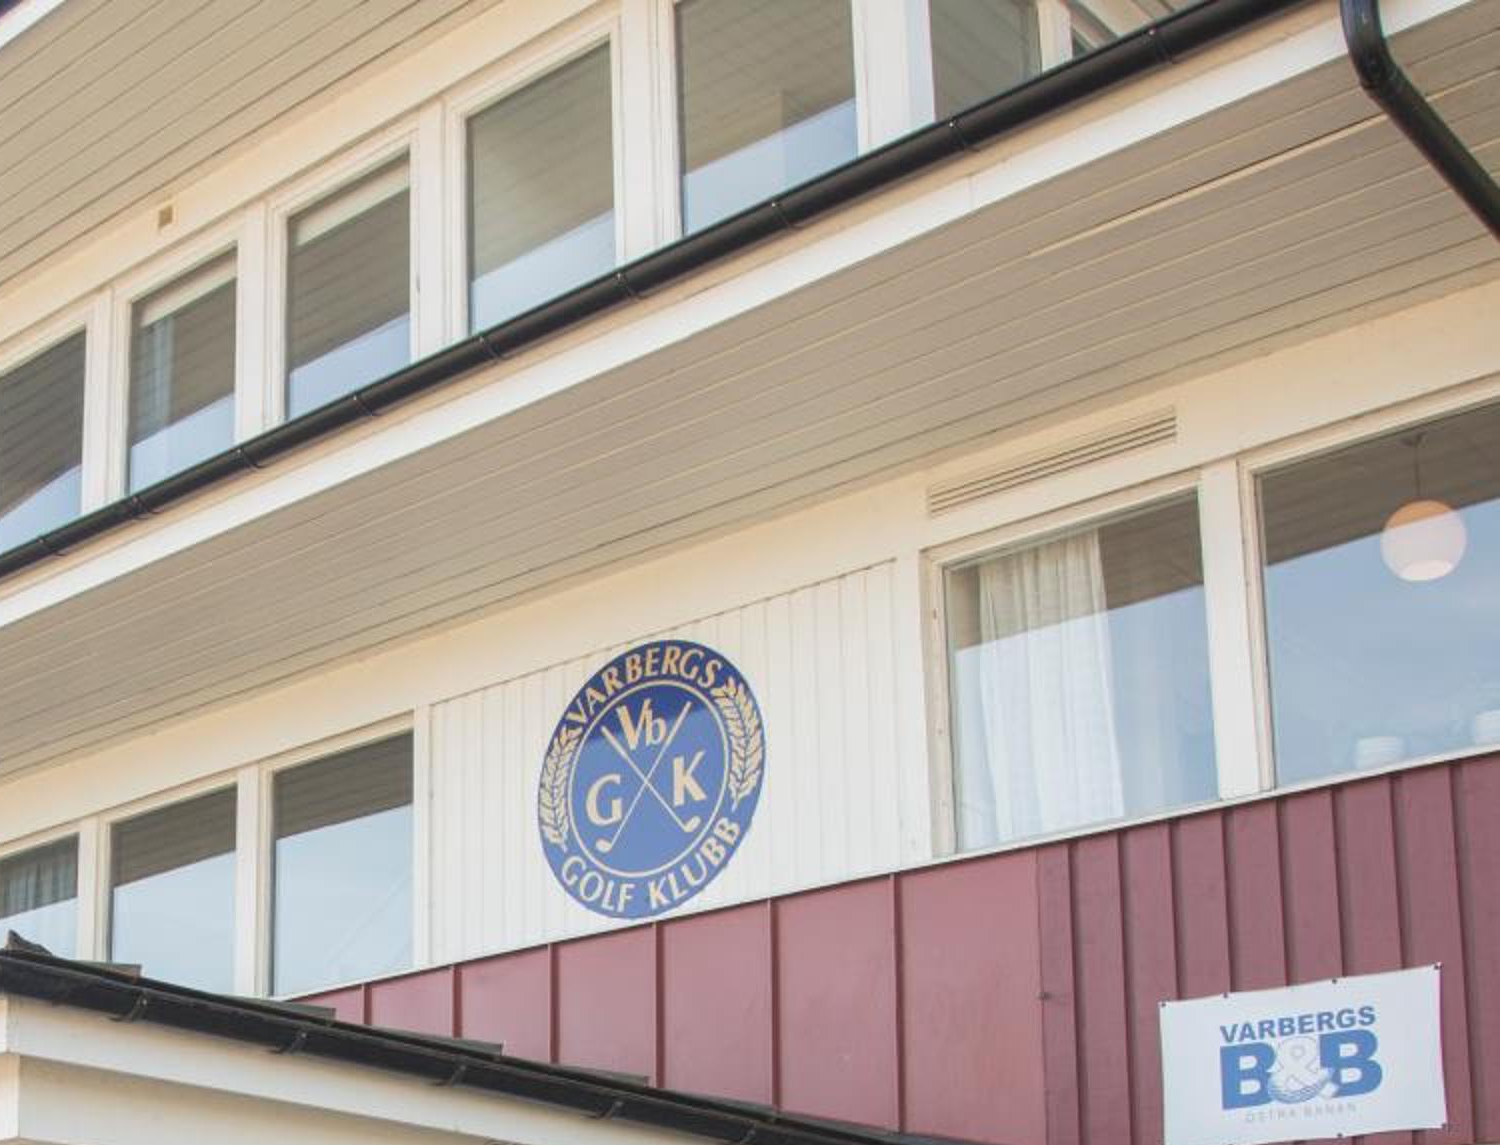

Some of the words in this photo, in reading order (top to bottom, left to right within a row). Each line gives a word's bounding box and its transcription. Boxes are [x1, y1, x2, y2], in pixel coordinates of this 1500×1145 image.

[566, 646, 722, 726] VARBERGS
[585, 773, 624, 826] G
[672, 751, 707, 807] K
[561, 855, 634, 913] GOLF
[649, 816, 740, 909] KLUBB
[1220, 1005, 1376, 1042] VARBERGS
